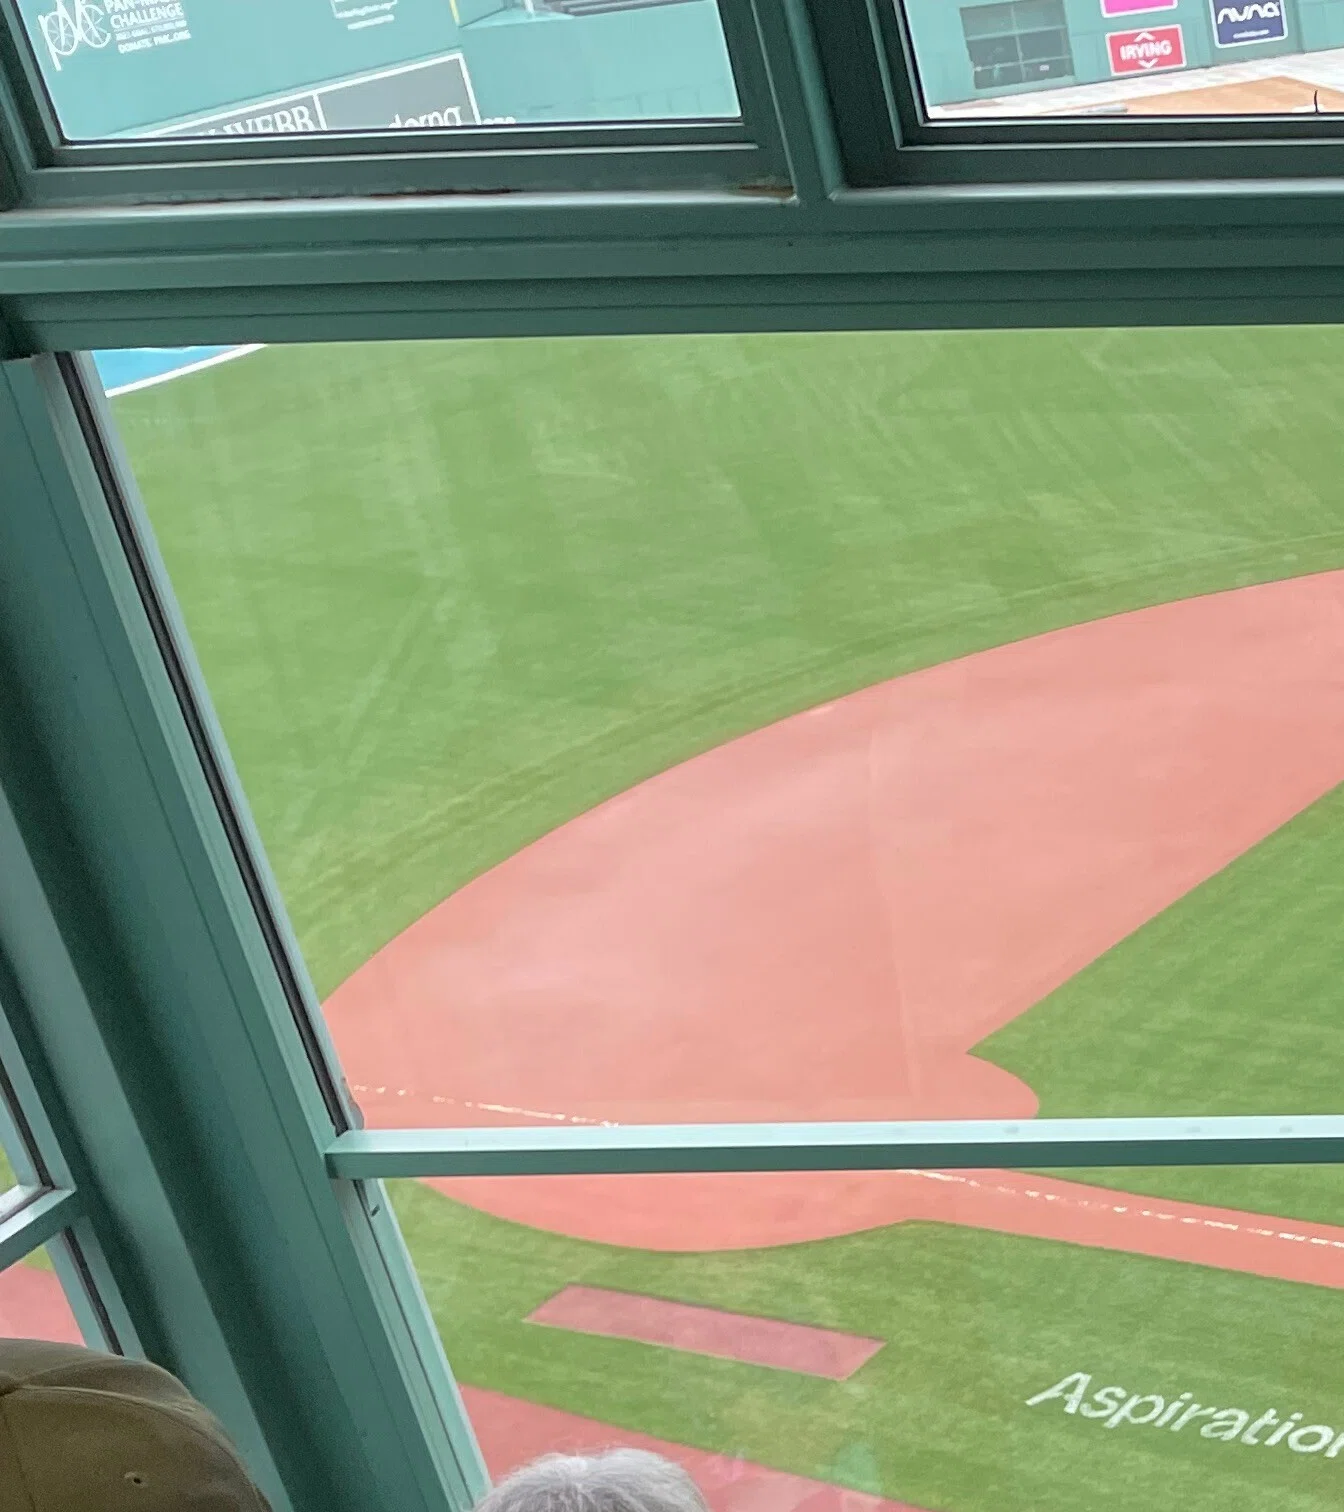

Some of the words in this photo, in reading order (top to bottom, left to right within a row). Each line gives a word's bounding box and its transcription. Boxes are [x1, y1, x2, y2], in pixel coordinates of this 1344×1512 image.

[110, 3, 184, 29] CHALLENGE
[1217, 2, 1281, 24] nuna
[1119, 40, 1172, 61] IRVING
